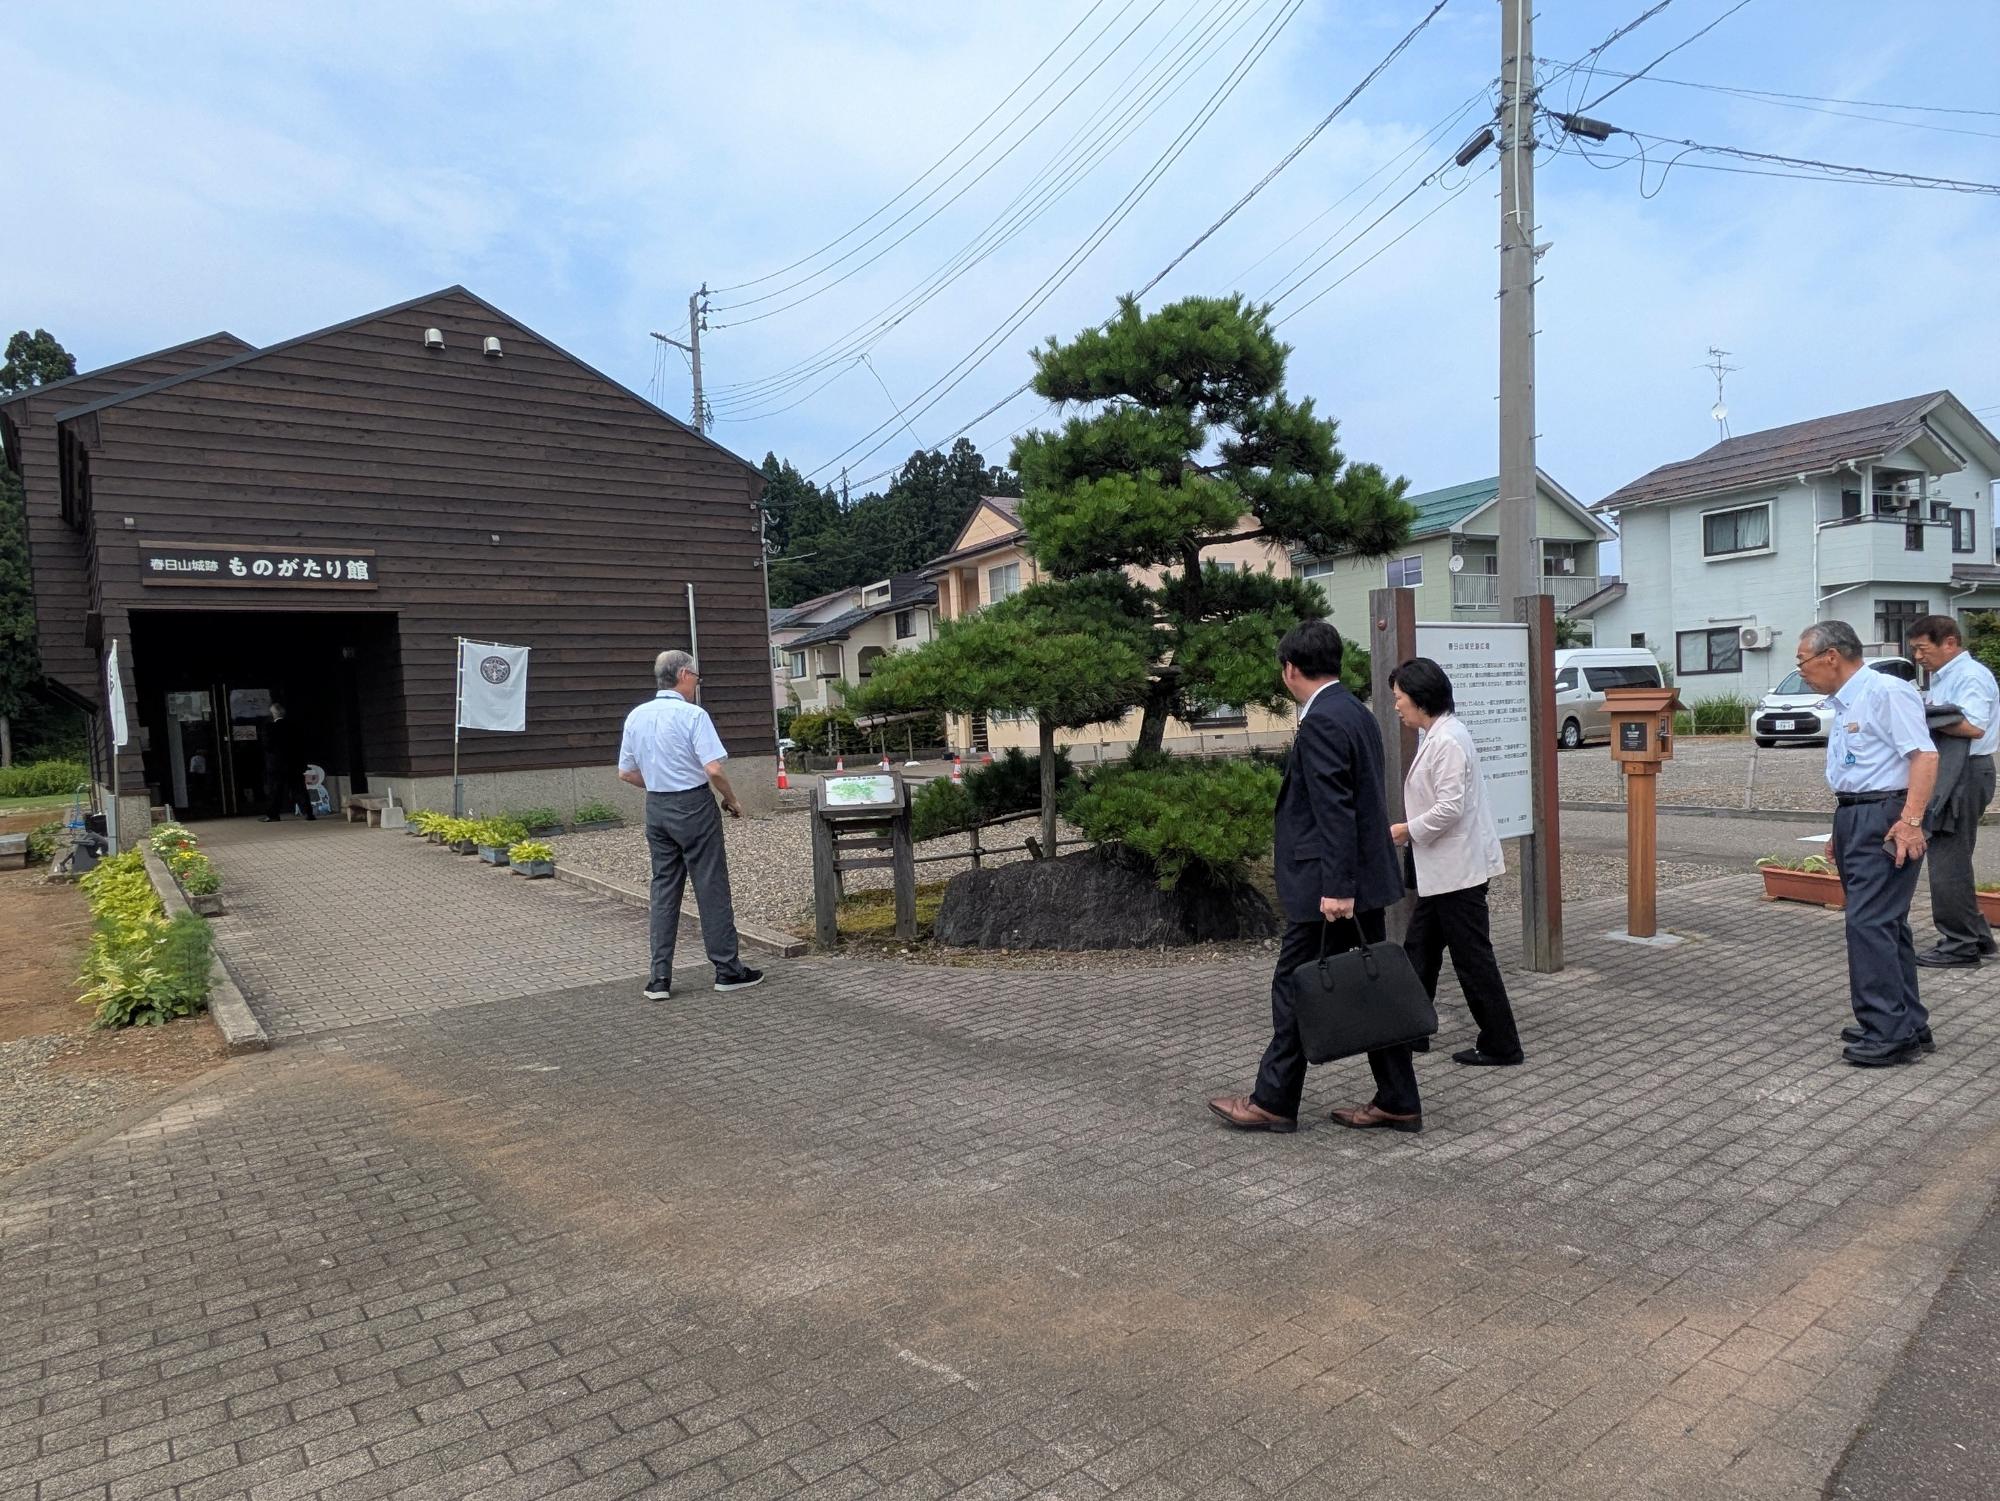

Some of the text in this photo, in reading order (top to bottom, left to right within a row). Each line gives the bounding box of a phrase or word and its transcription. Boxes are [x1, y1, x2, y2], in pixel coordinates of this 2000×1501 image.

[150, 556, 369, 580] 春日山城跡 ものがたり館
